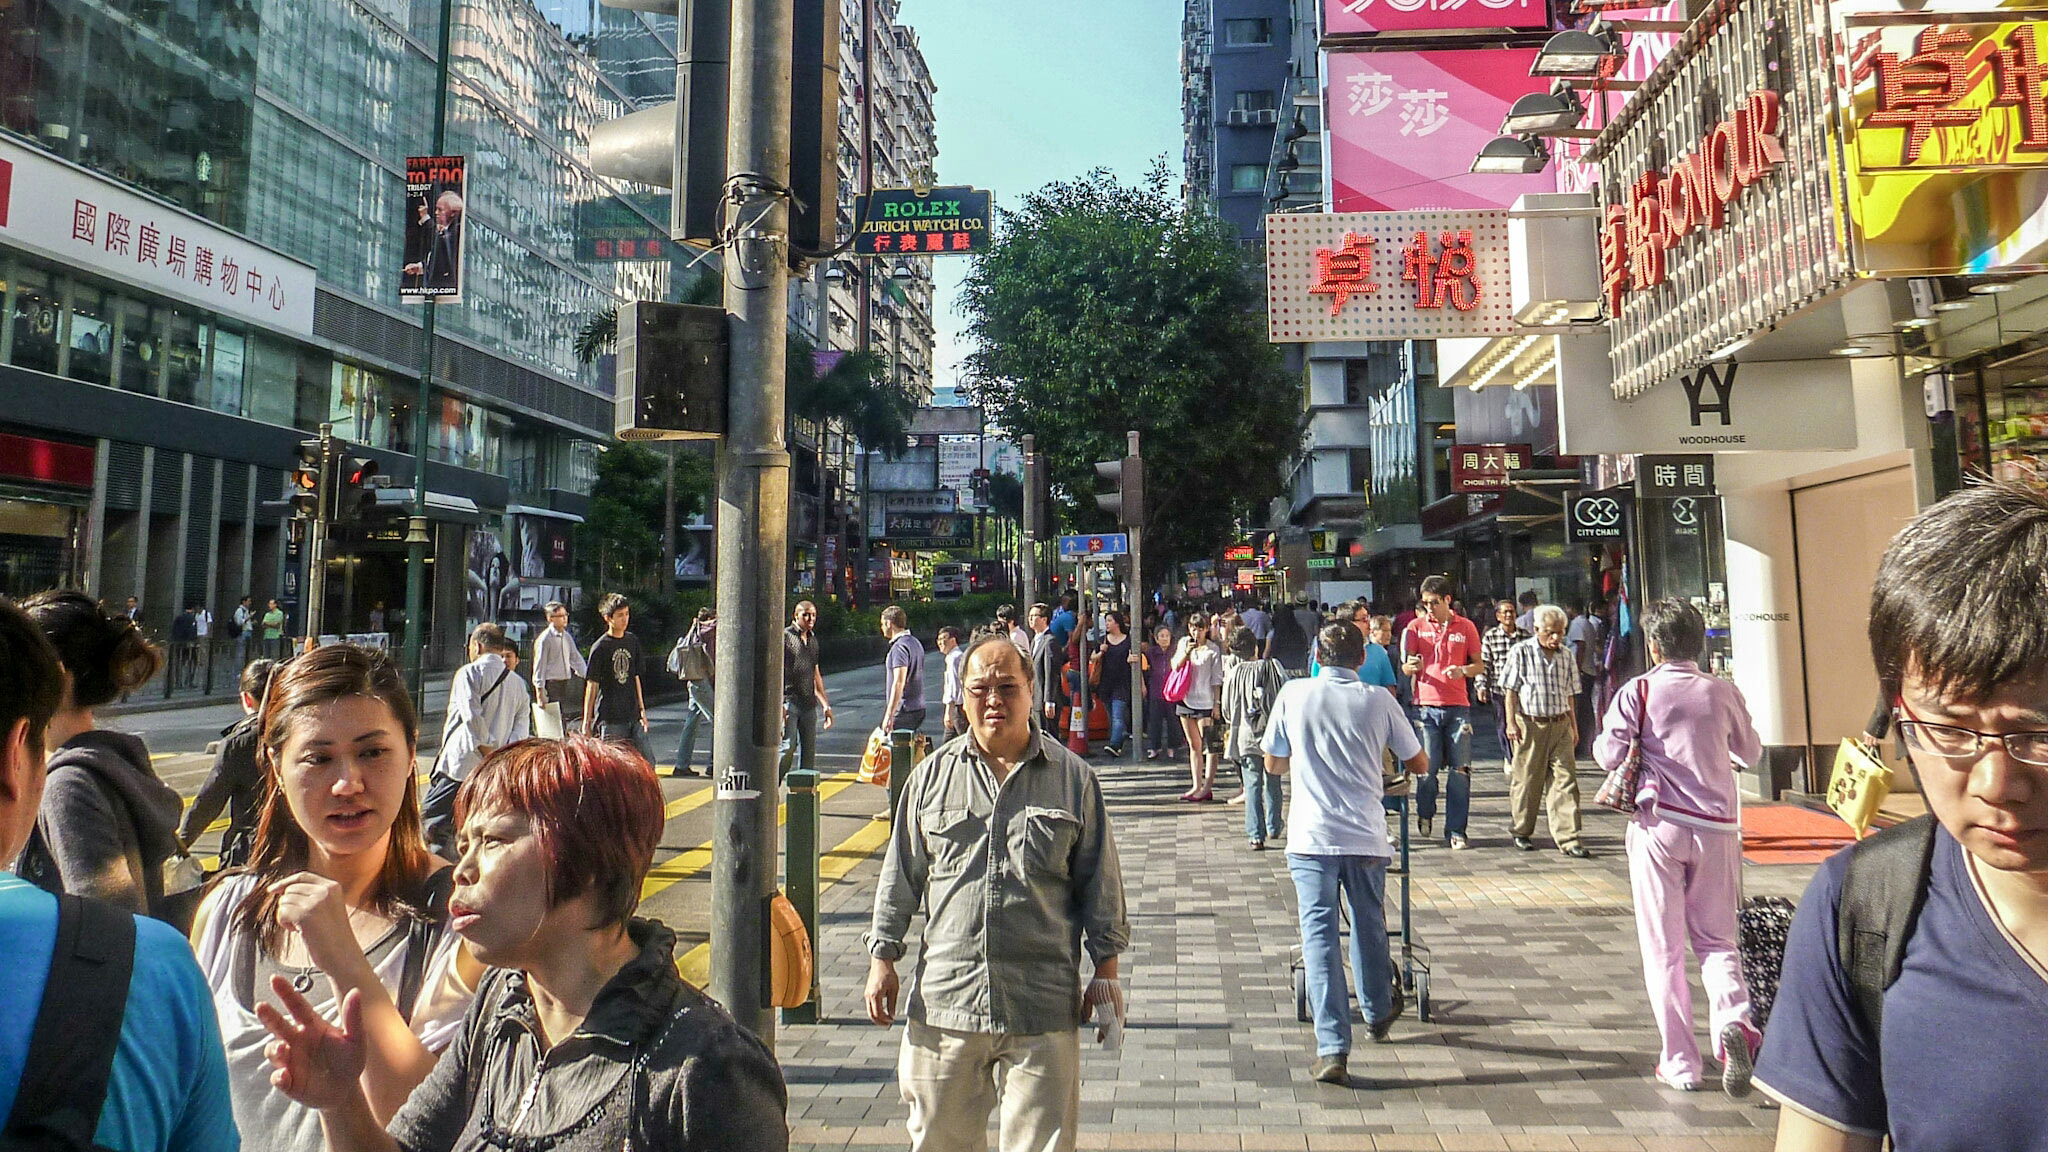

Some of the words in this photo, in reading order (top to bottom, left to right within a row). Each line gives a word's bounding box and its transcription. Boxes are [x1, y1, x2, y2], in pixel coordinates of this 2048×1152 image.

[1346, 72, 1449, 138] 莎莎
[407, 171, 426, 184] TO
[429, 168, 463, 184] EDO
[406, 184, 432, 192] TRILOGY
[884, 201, 960, 217] ROLEX
[861, 220, 910, 233] ZURICH
[912, 219, 960, 232] WATCH
[962, 217, 984, 231] CO.
[72, 199, 286, 311] 國際廣場購物中心
[400, 286, 457, 295] www.hkpo.com
[1679, 435, 1747, 444] WOODHOUSE
[1462, 452, 1521, 471] 周大福
[1654, 464, 1705, 487] 時間
[1576, 528, 1595, 536] CITY
[1595, 528, 1620, 536] CHAIN
[1308, 559, 1333, 567] ROLEX
[719, 775, 750, 791] RVL
